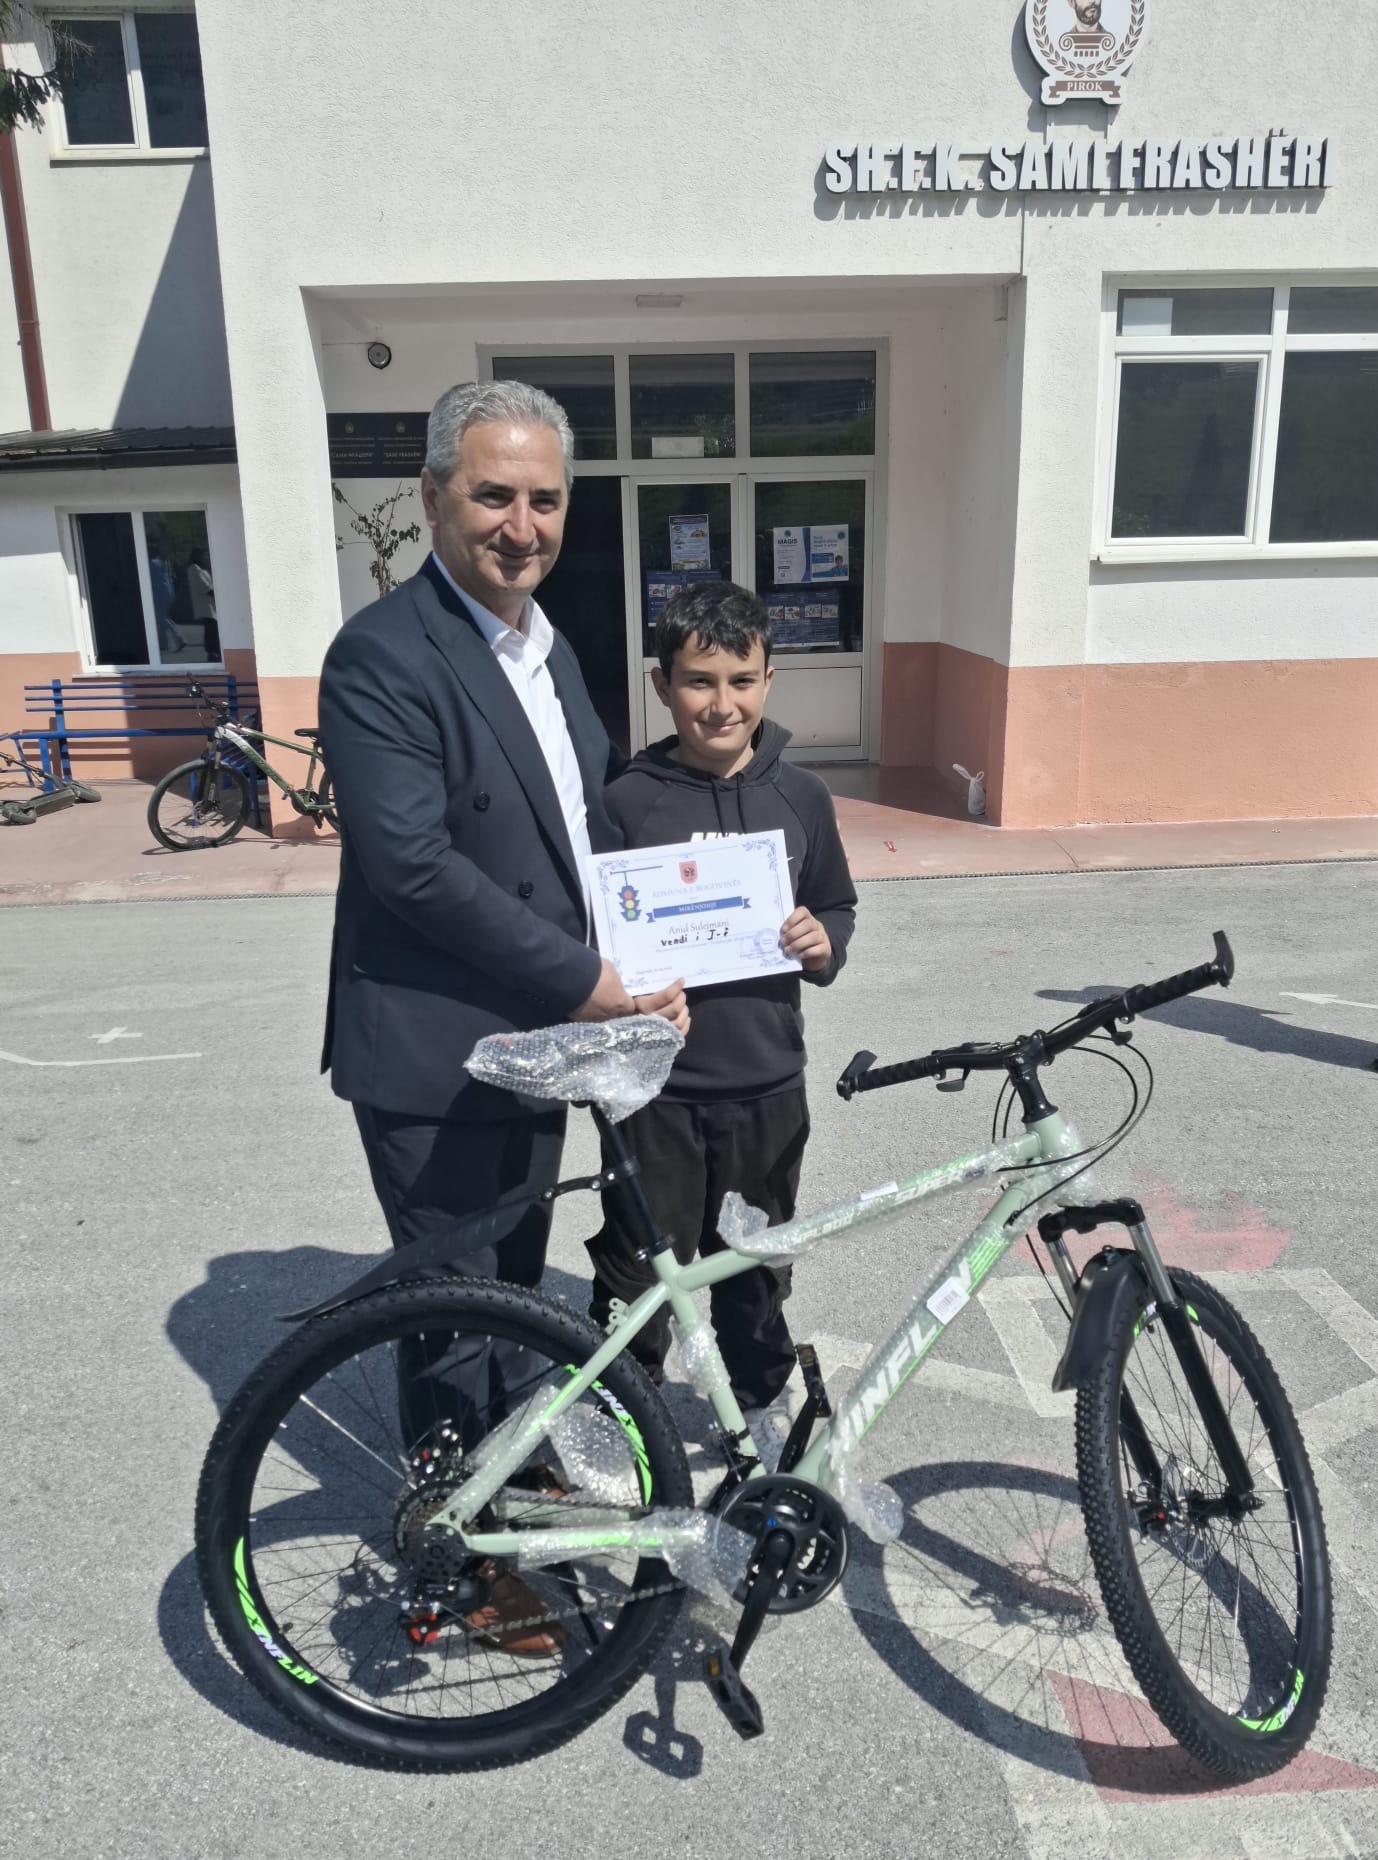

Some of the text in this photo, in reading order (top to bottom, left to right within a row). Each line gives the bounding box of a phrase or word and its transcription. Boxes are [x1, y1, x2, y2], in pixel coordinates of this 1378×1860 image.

[1067, 81, 1103, 91] PIROK
[989, 141, 1108, 191] SAMI
[1119, 127, 1336, 189] FRASHËRI
